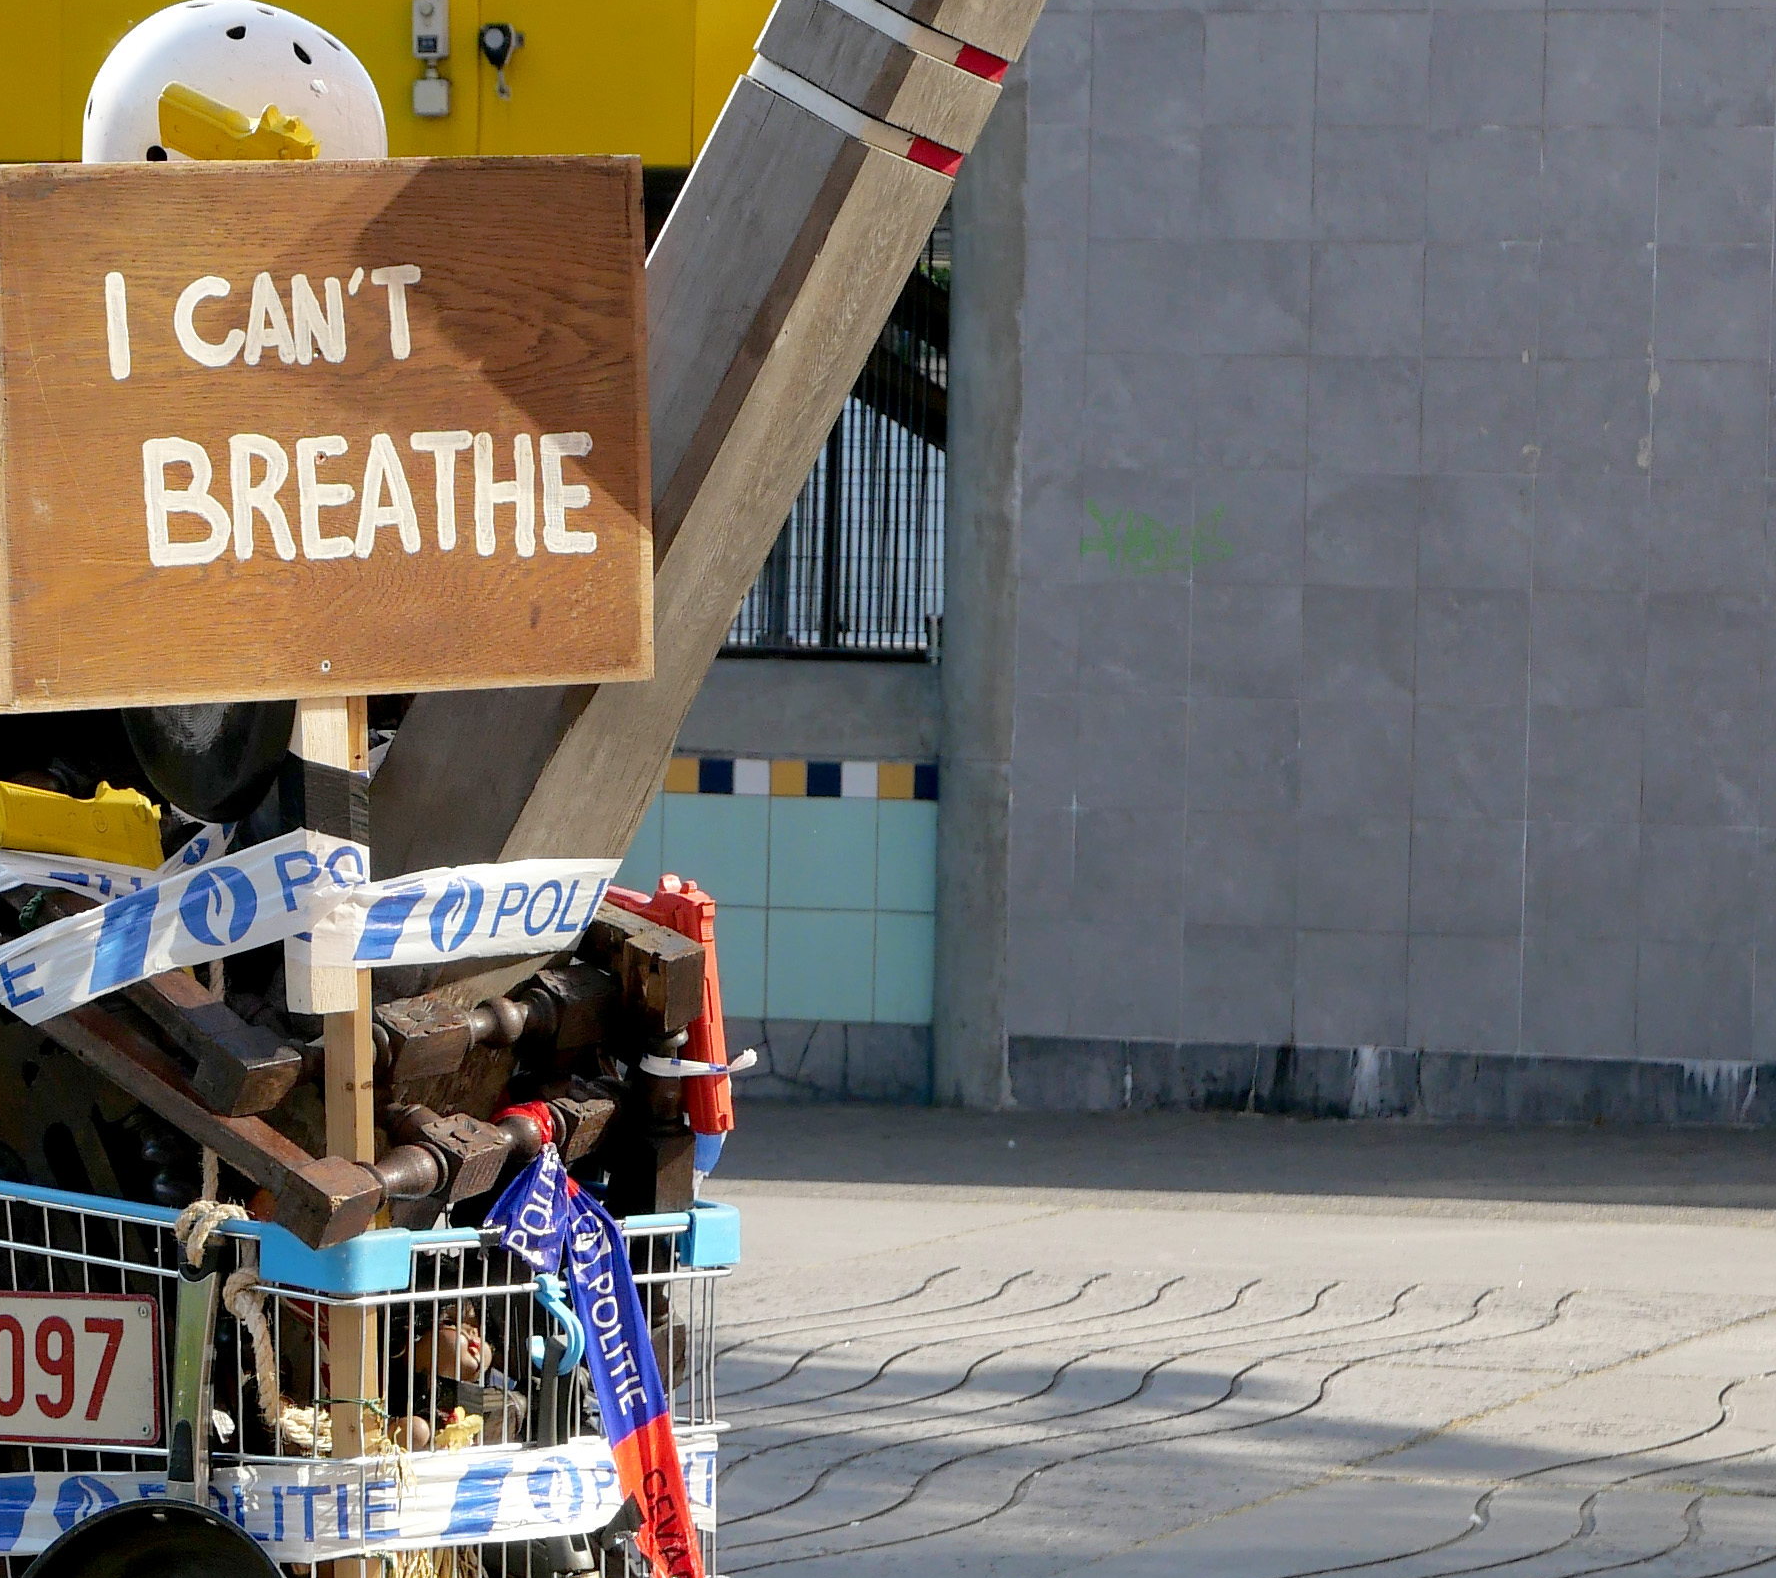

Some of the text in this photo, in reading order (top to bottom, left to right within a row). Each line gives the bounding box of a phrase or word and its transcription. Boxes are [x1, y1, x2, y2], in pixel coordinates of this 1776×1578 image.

[104, 264, 422, 379] I CAN'T
[142, 430, 597, 567] BREATHE
[588, 1272, 648, 1416] POLITIE
[139, 1479, 402, 1543] LITIE
